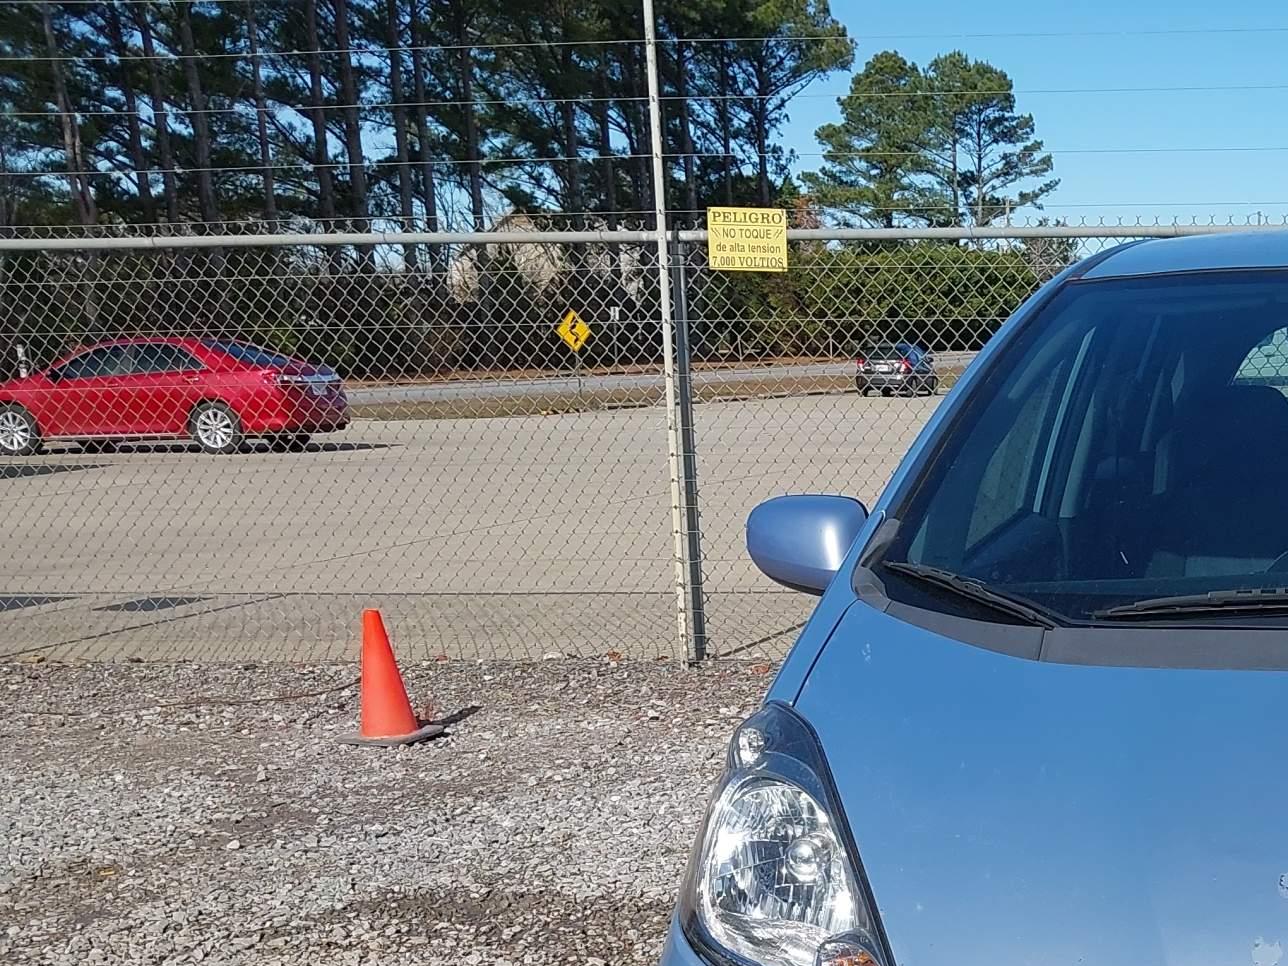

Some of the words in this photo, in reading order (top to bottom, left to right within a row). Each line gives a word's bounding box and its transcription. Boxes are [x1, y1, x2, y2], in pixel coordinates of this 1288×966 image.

[711, 211, 782, 224] PELIGRO
[722, 228, 736, 239] NO
[739, 228, 772, 239] TOQUE
[716, 242, 727, 252] de
[729, 243, 745, 252] alta
[748, 243, 781, 253] tension
[738, 256, 784, 268] VOLTIOS
